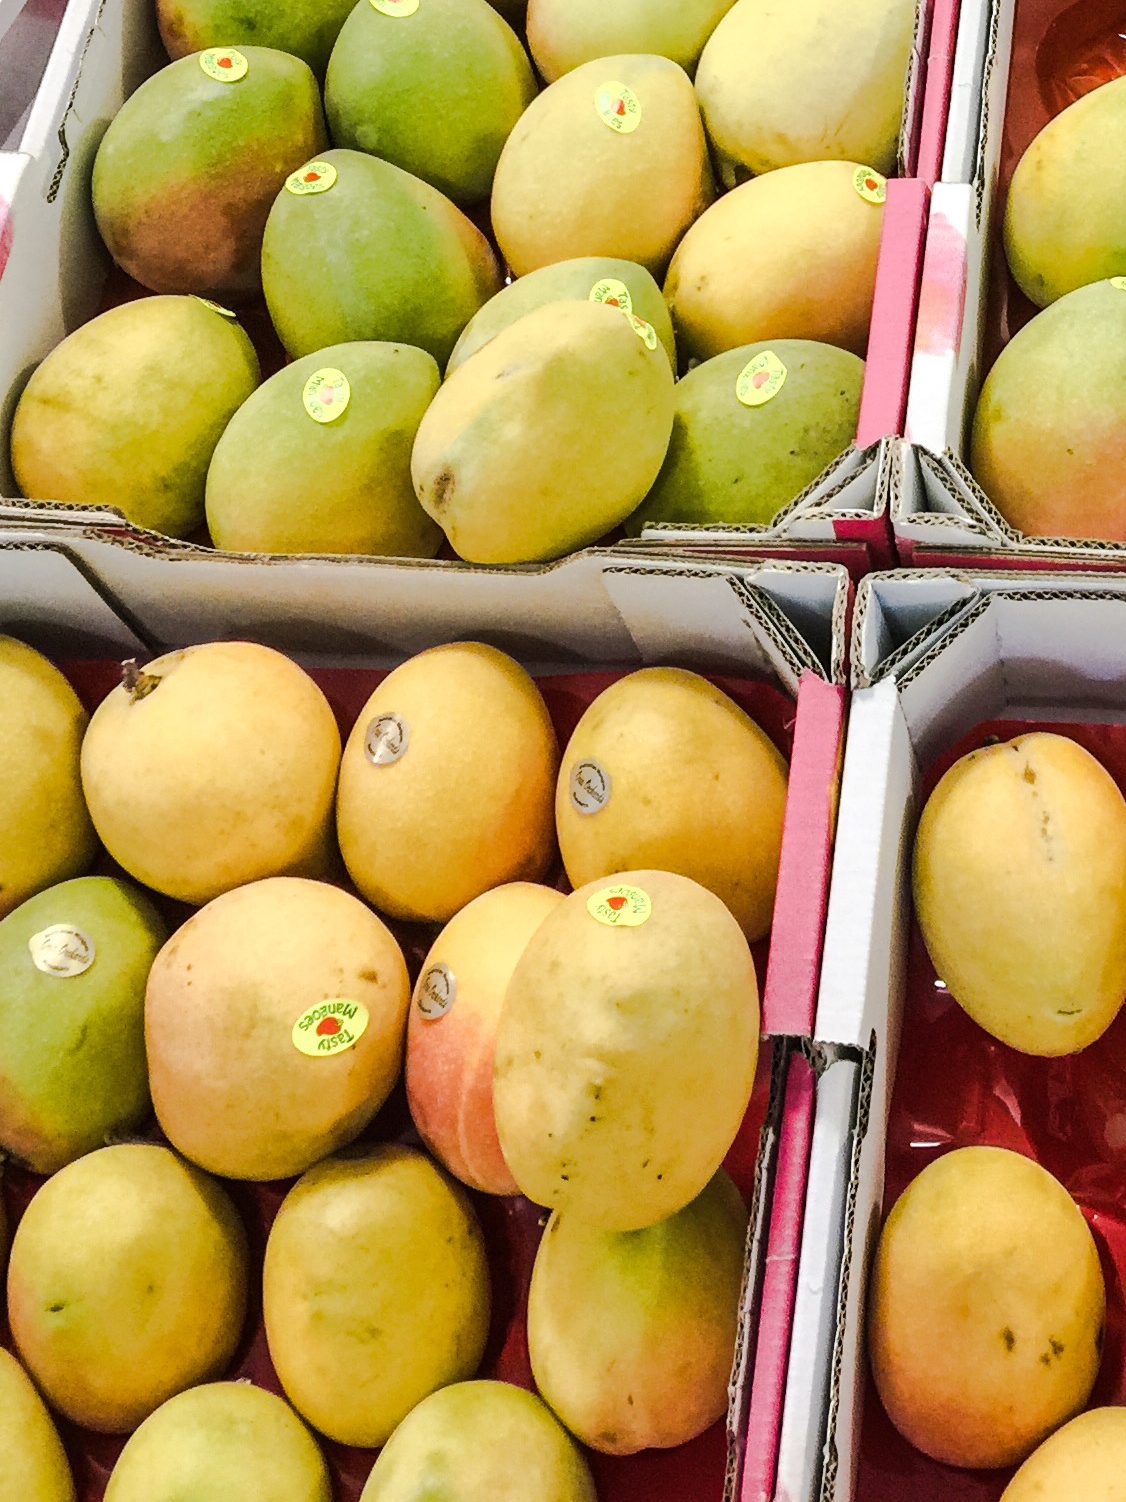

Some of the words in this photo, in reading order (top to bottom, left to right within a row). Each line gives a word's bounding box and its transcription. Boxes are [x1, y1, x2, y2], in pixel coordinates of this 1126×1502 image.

[621, 89, 636, 114] Tasty
[308, 375, 324, 418] Manoes
[298, 1002, 359, 1032] Mangoes
[317, 1028, 355, 1051] Tasty
